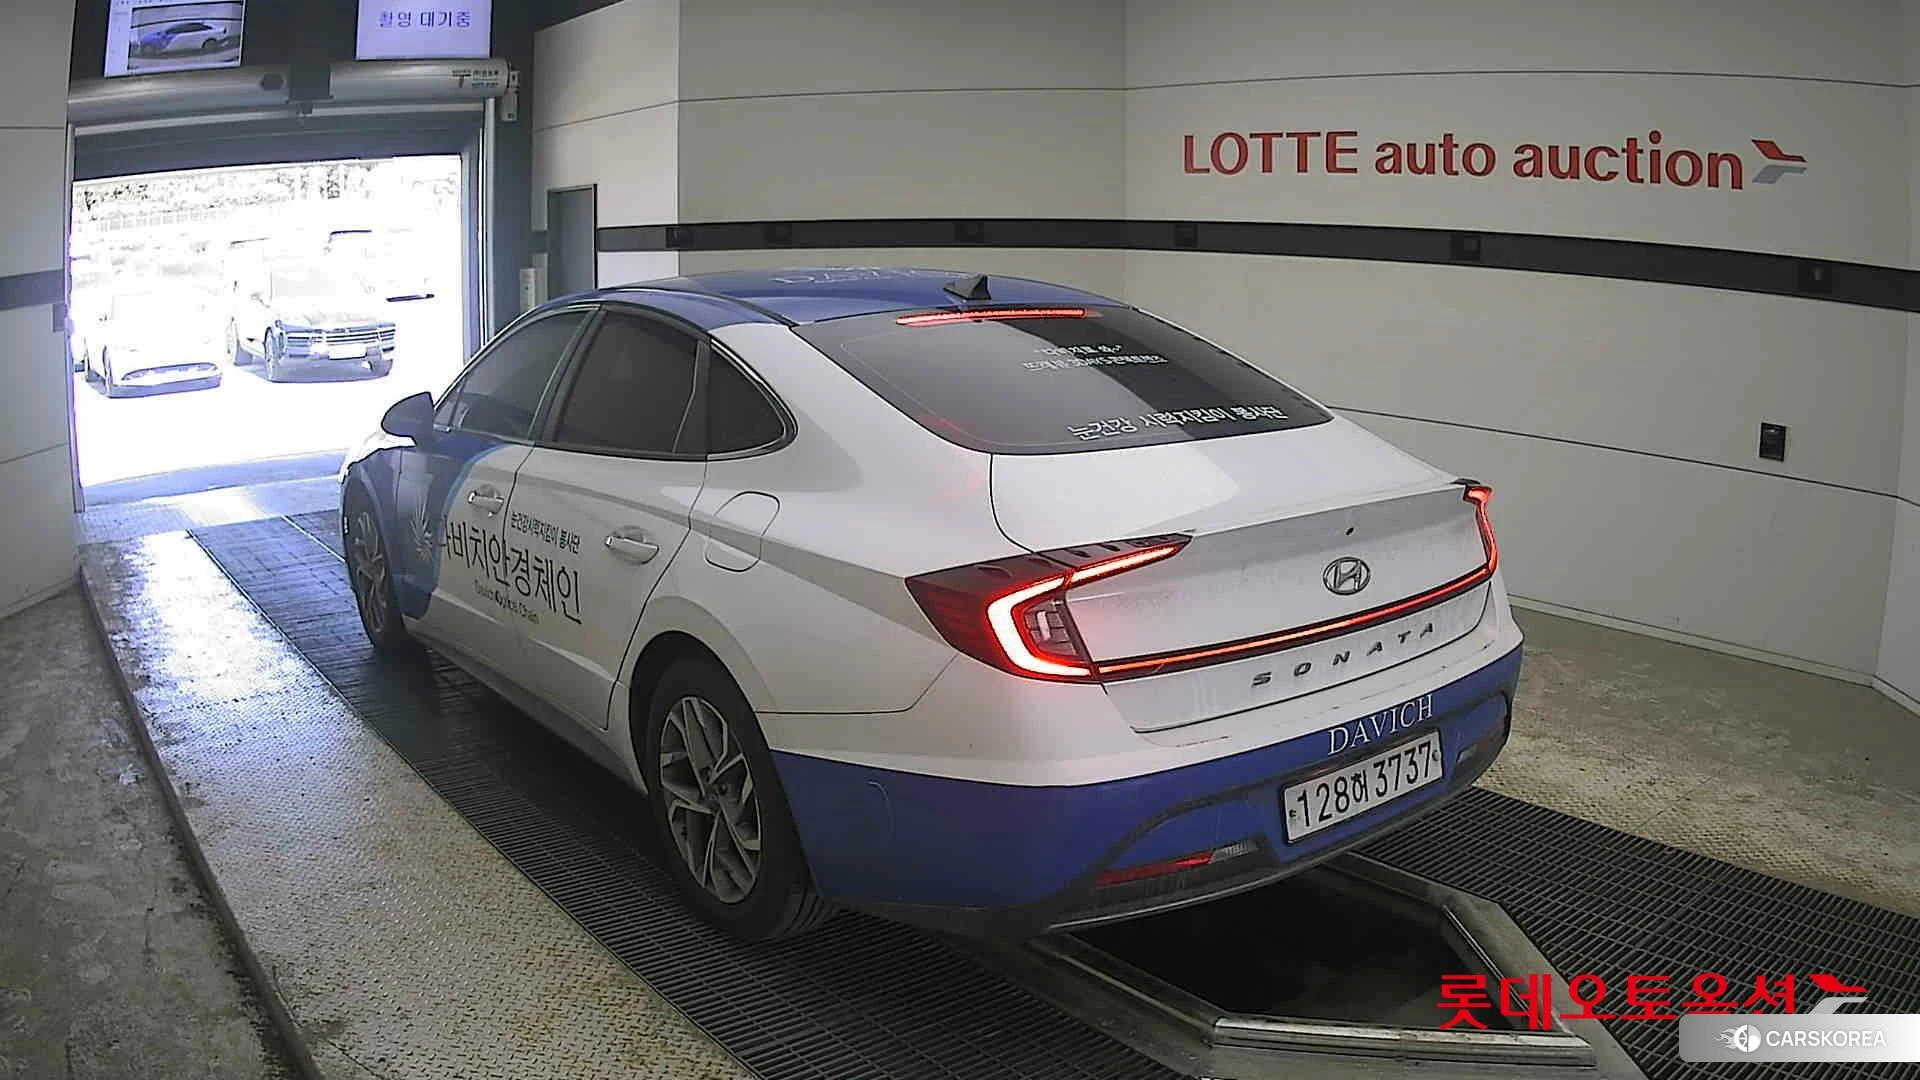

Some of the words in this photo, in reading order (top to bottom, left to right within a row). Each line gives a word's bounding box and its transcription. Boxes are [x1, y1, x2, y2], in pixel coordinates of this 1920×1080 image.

[420, 11, 470, 28] 대기중
[1184, 131, 1359, 175] LOTTE
[1376, 133, 1496, 178] auto
[1513, 131, 1744, 190] auction
[1068, 416, 1137, 440] 눈건강
[1139, 407, 1232, 428] 시력지킴이
[1251, 623, 1434, 687] SONATA
[1328, 694, 1434, 756] DAVICH
[1298, 769, 1369, 828] 128허
[1373, 741, 1433, 798] 3737
